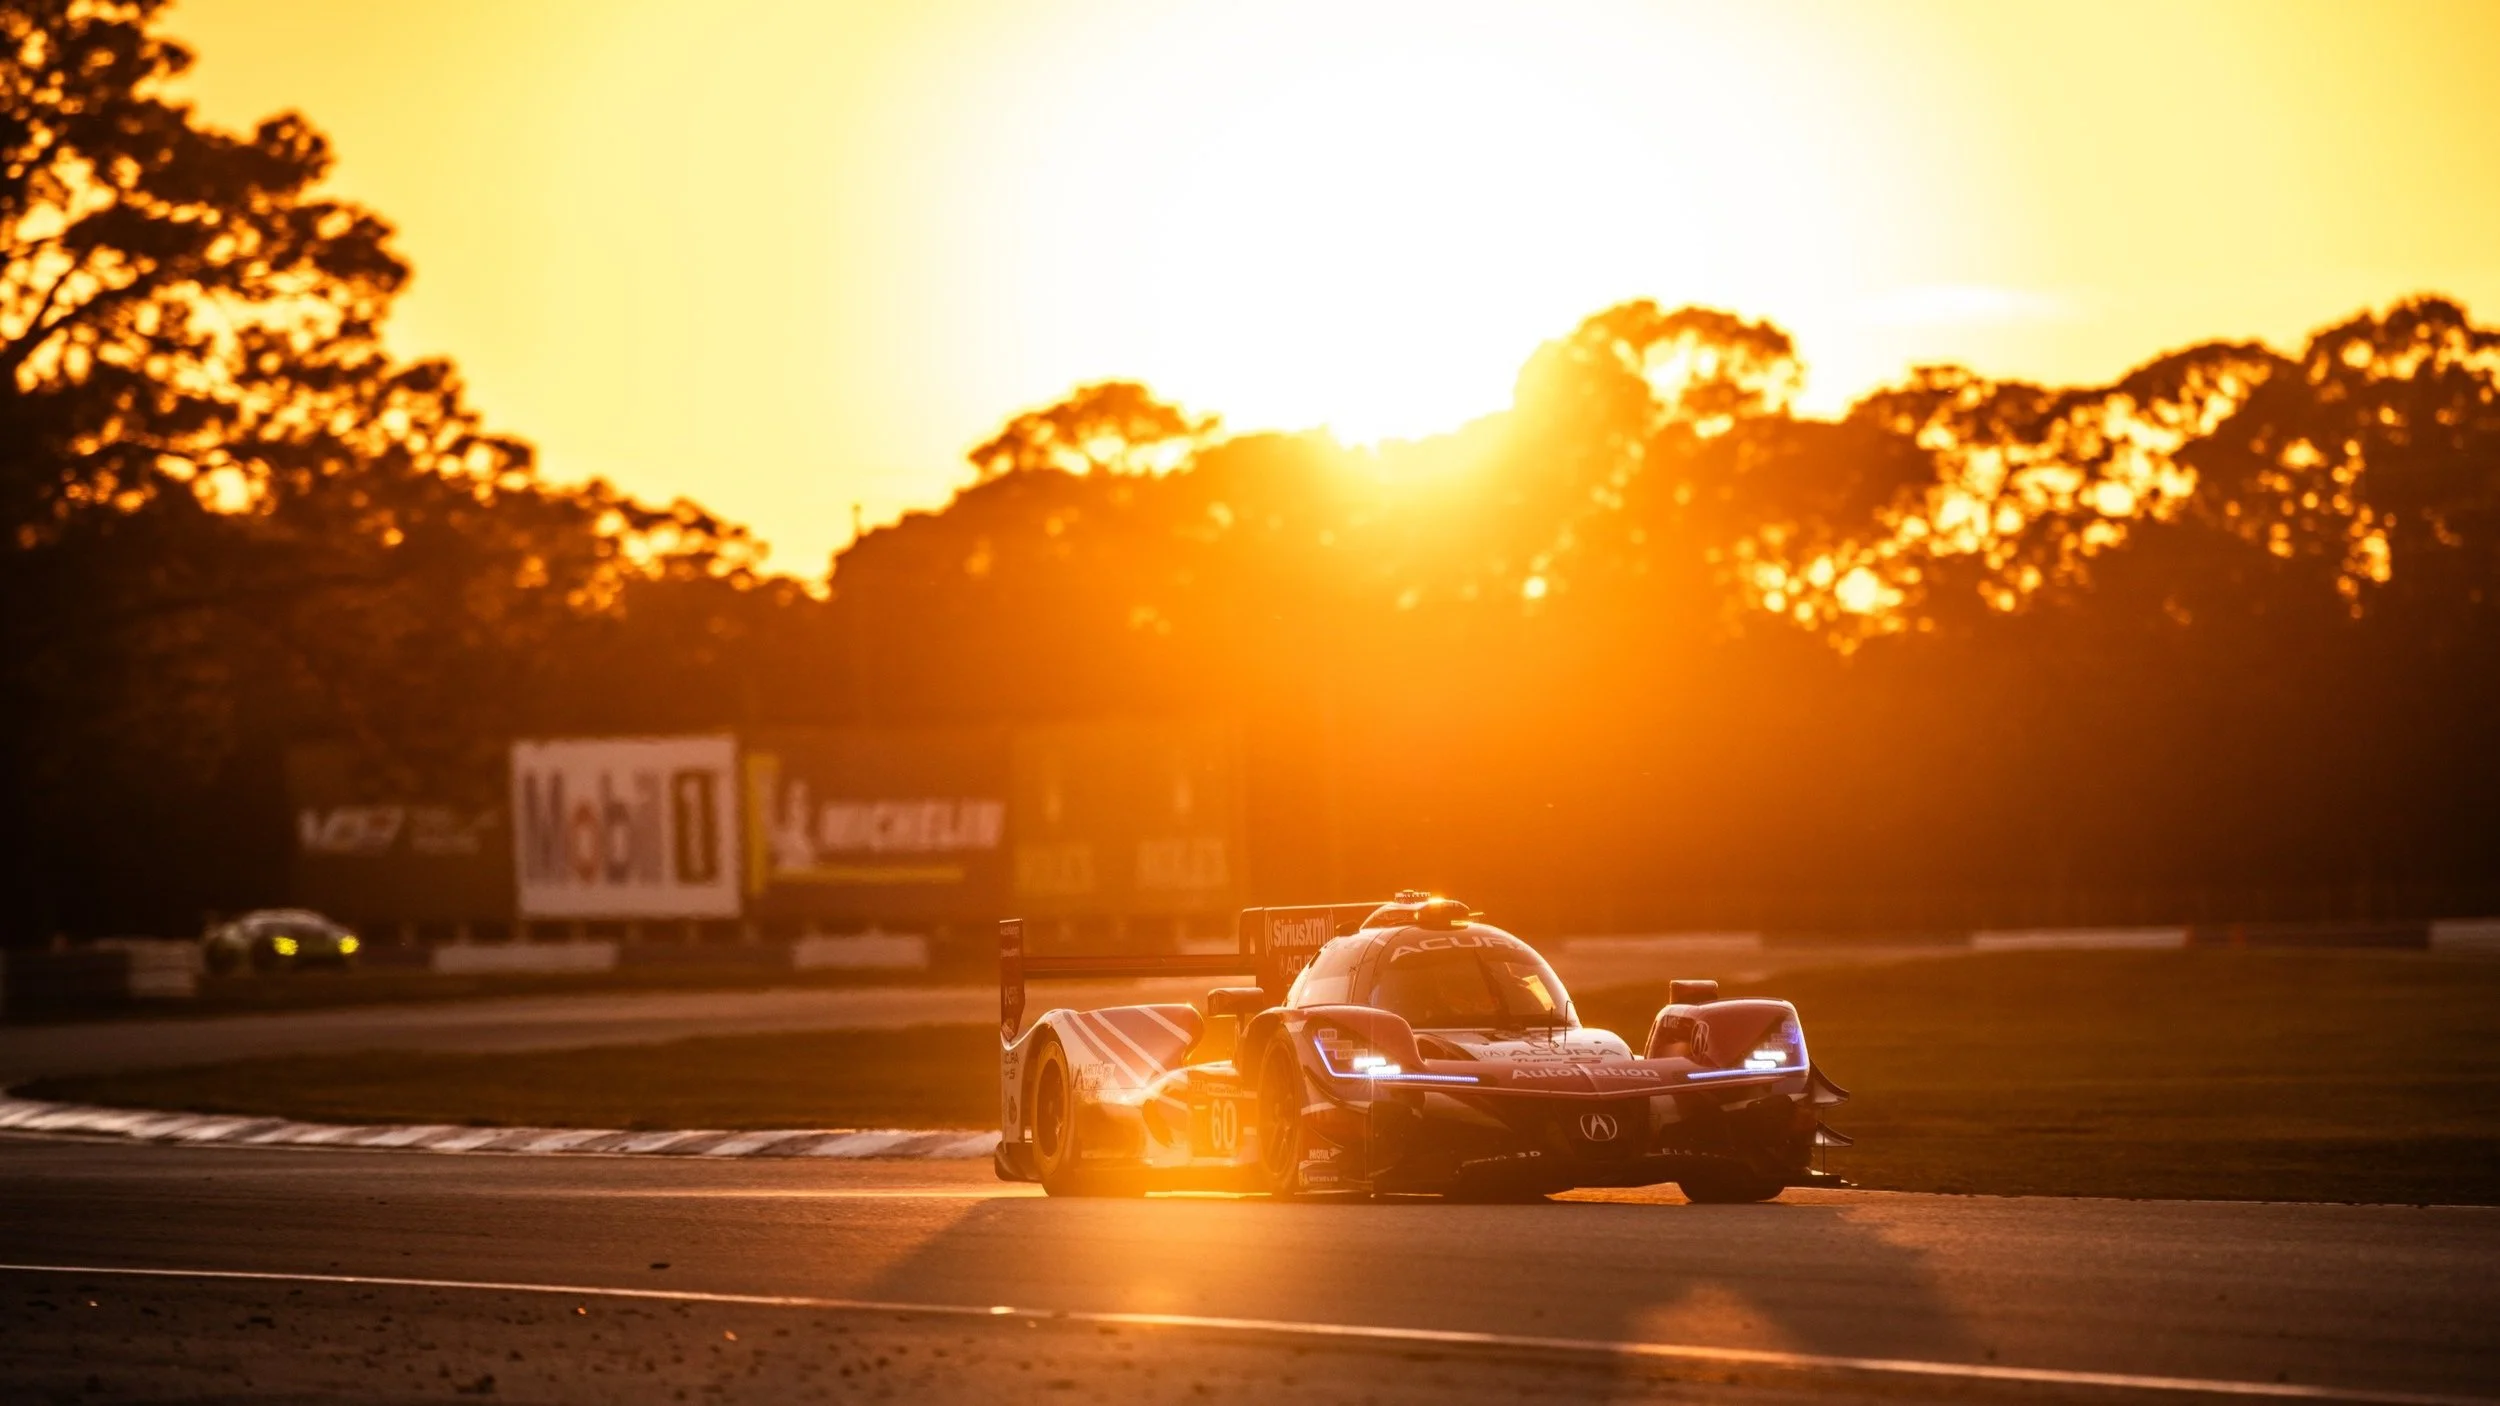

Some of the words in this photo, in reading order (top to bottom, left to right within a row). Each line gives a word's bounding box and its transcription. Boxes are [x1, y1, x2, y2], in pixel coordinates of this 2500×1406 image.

[524, 769, 662, 885] Mobil
[1509, 1048, 1622, 1057] ACURA
[1512, 1067, 1660, 1080] AutoNation
[1211, 1098, 1238, 1151] 60
